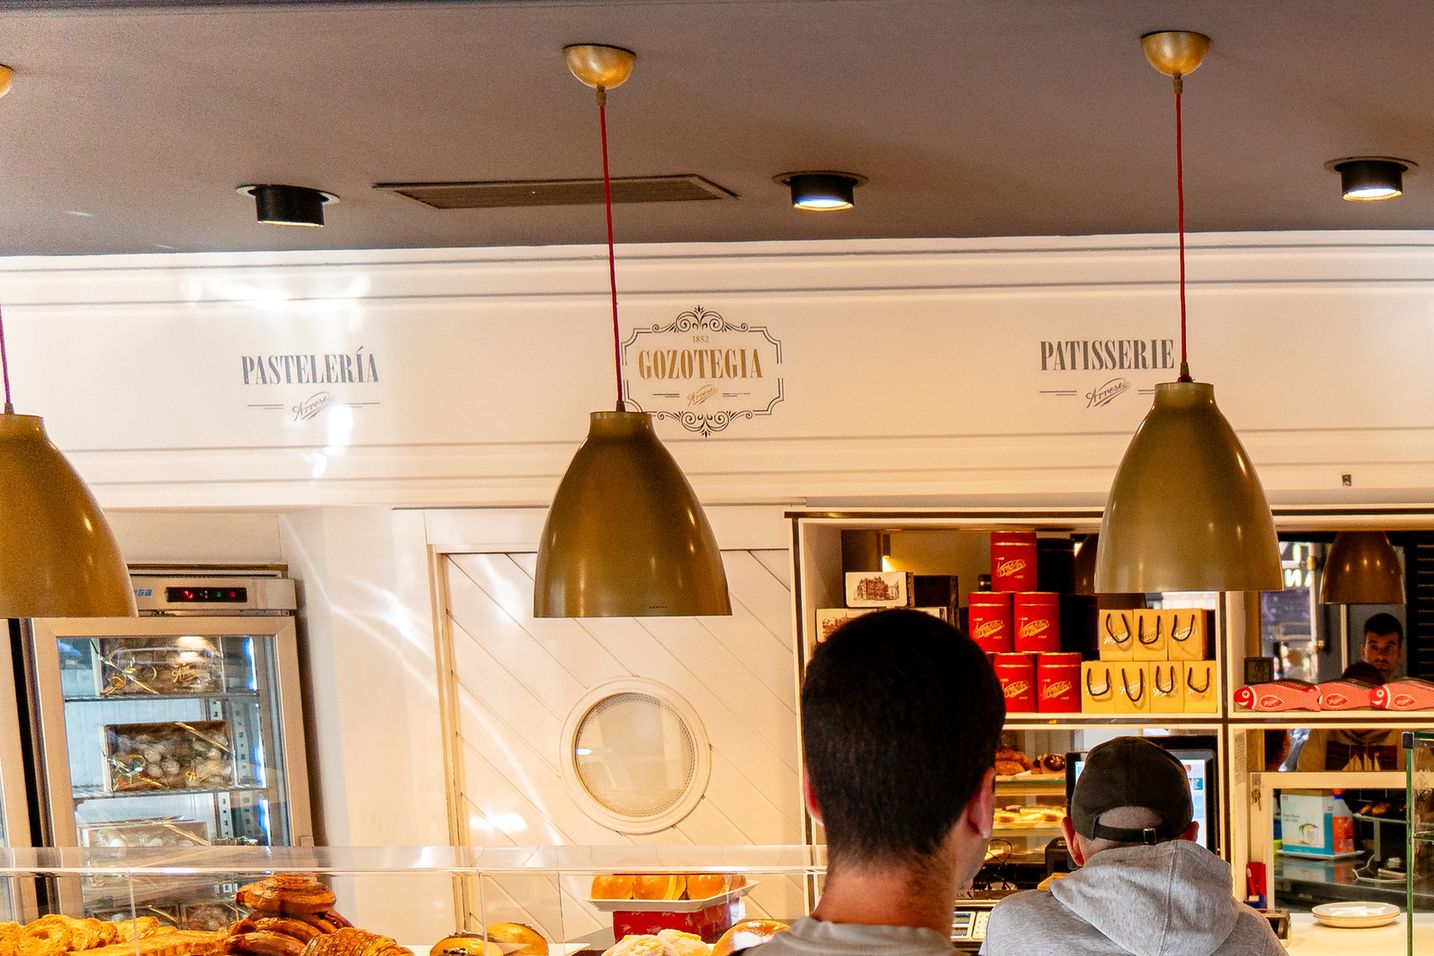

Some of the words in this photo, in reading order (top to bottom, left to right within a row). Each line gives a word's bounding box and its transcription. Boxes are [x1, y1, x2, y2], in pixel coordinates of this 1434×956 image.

[692, 335, 710, 344] 1852
[1040, 339, 1175, 371] PATISSERIE
[241, 346, 380, 385] PASTELERÍA
[638, 348, 763, 380] GOZOTEGIA
